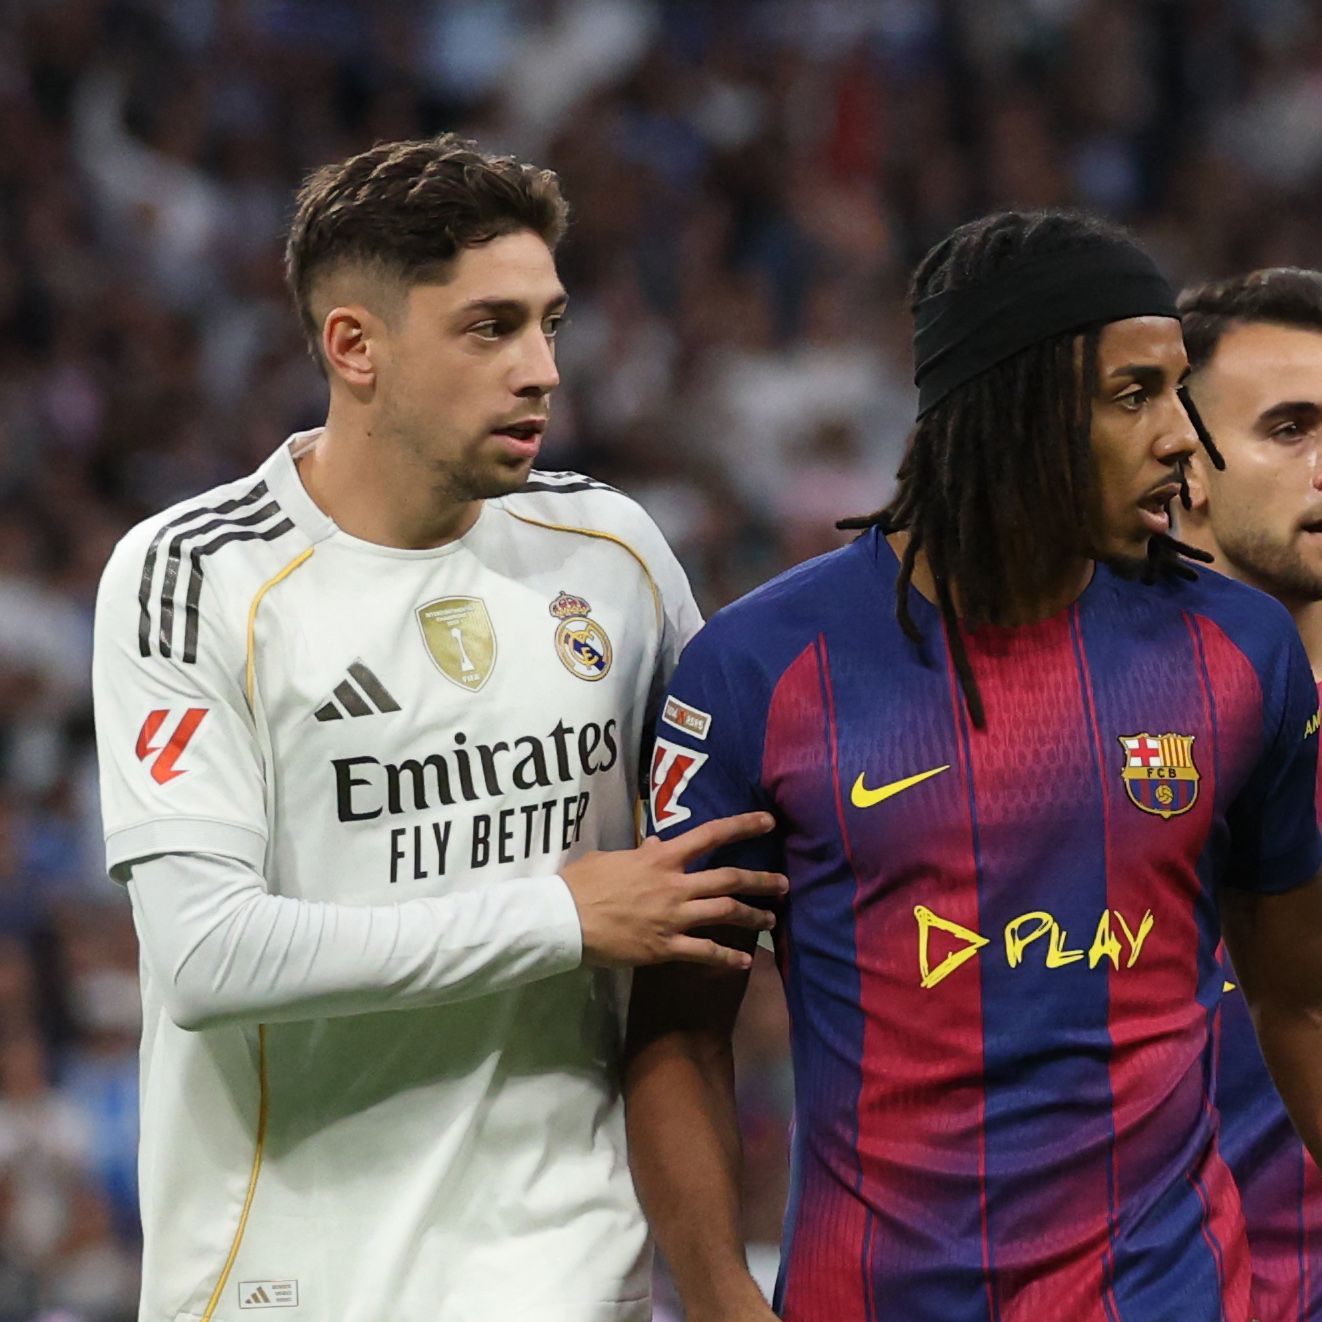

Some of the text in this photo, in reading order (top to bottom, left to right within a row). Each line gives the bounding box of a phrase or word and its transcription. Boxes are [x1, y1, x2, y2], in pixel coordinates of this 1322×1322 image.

[330, 717, 617, 823] Emirates
[1146, 768, 1177, 778] FCB
[389, 791, 591, 884] FLY BETTER
[1004, 908, 1154, 971] PLAY
